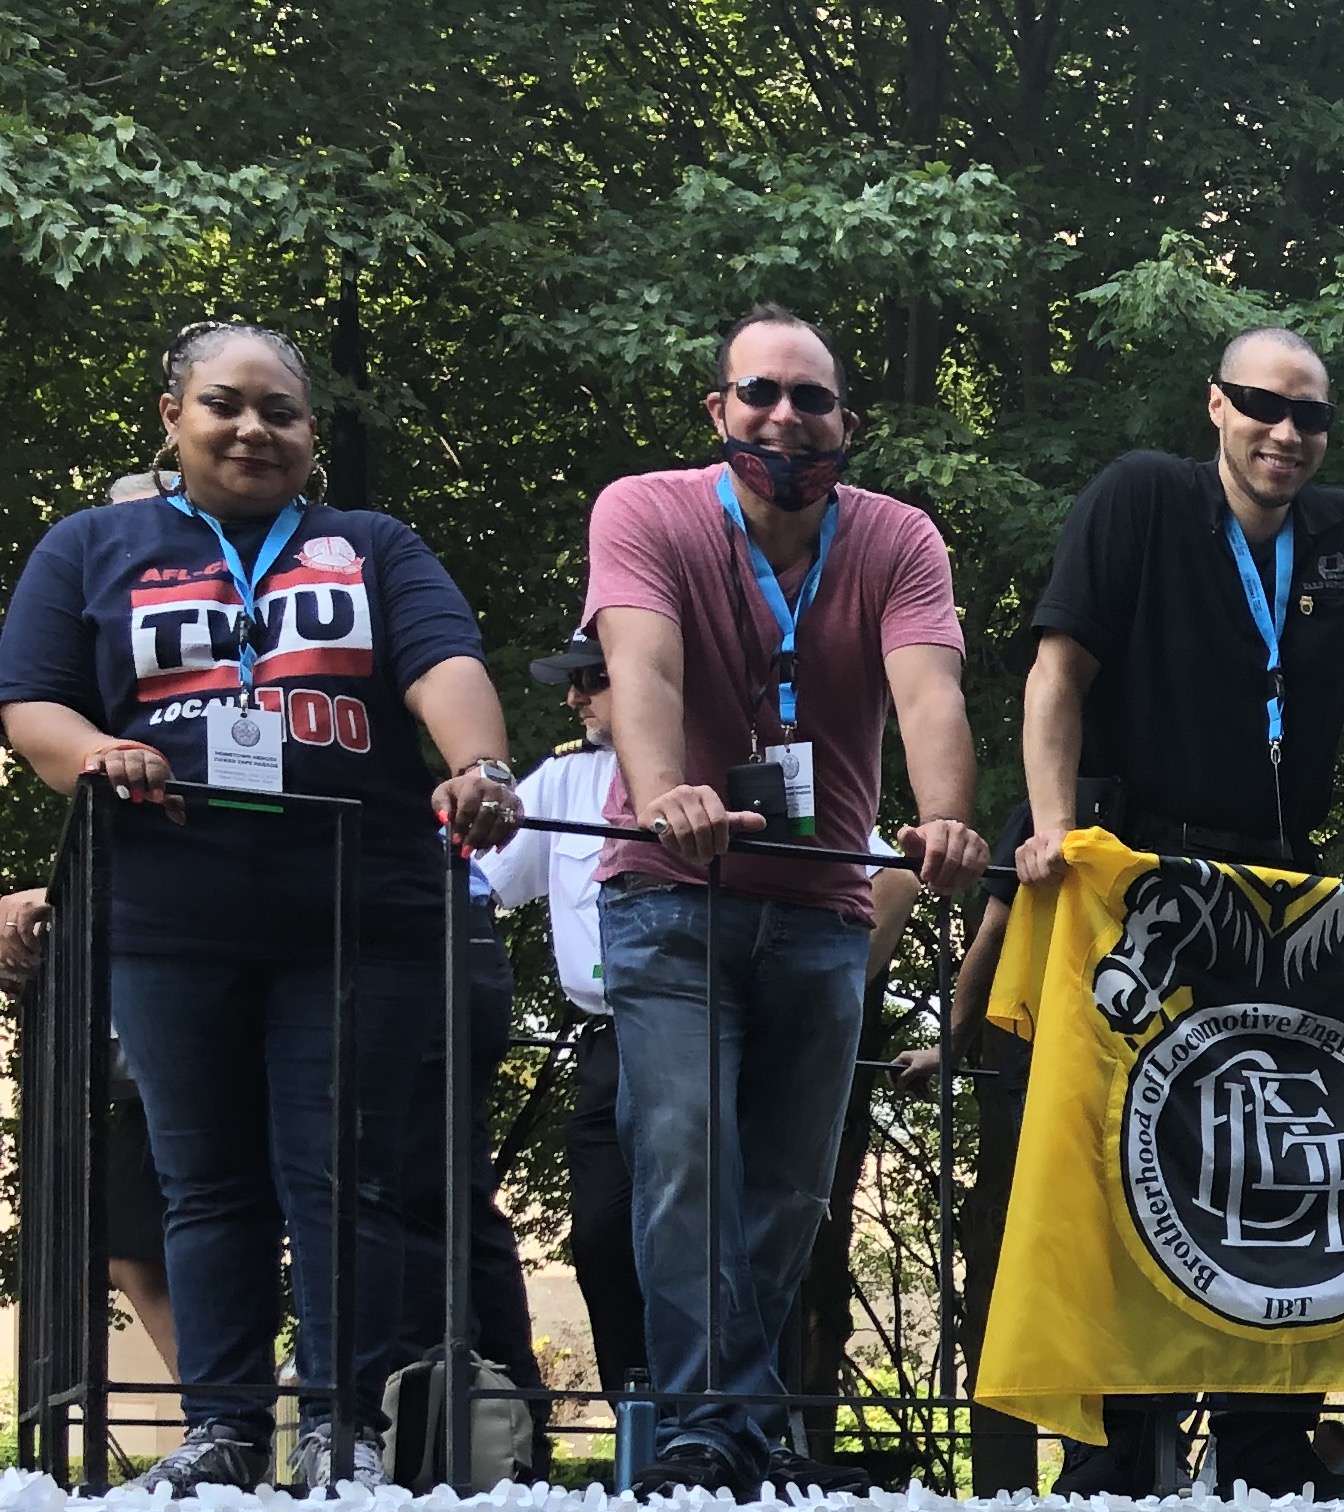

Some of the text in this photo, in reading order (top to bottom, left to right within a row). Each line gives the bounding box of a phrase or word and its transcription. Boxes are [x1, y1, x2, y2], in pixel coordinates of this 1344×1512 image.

[141, 559, 229, 583] AFL-CI
[140, 588, 355, 670] TWU
[255, 686, 371, 753] 100
[1147, 1006, 1292, 1081] Locomotive
[1142, 1068, 1166, 1105] of
[1135, 1107, 1220, 1295] Brotherhood
[1261, 1296, 1313, 1320] IBT
